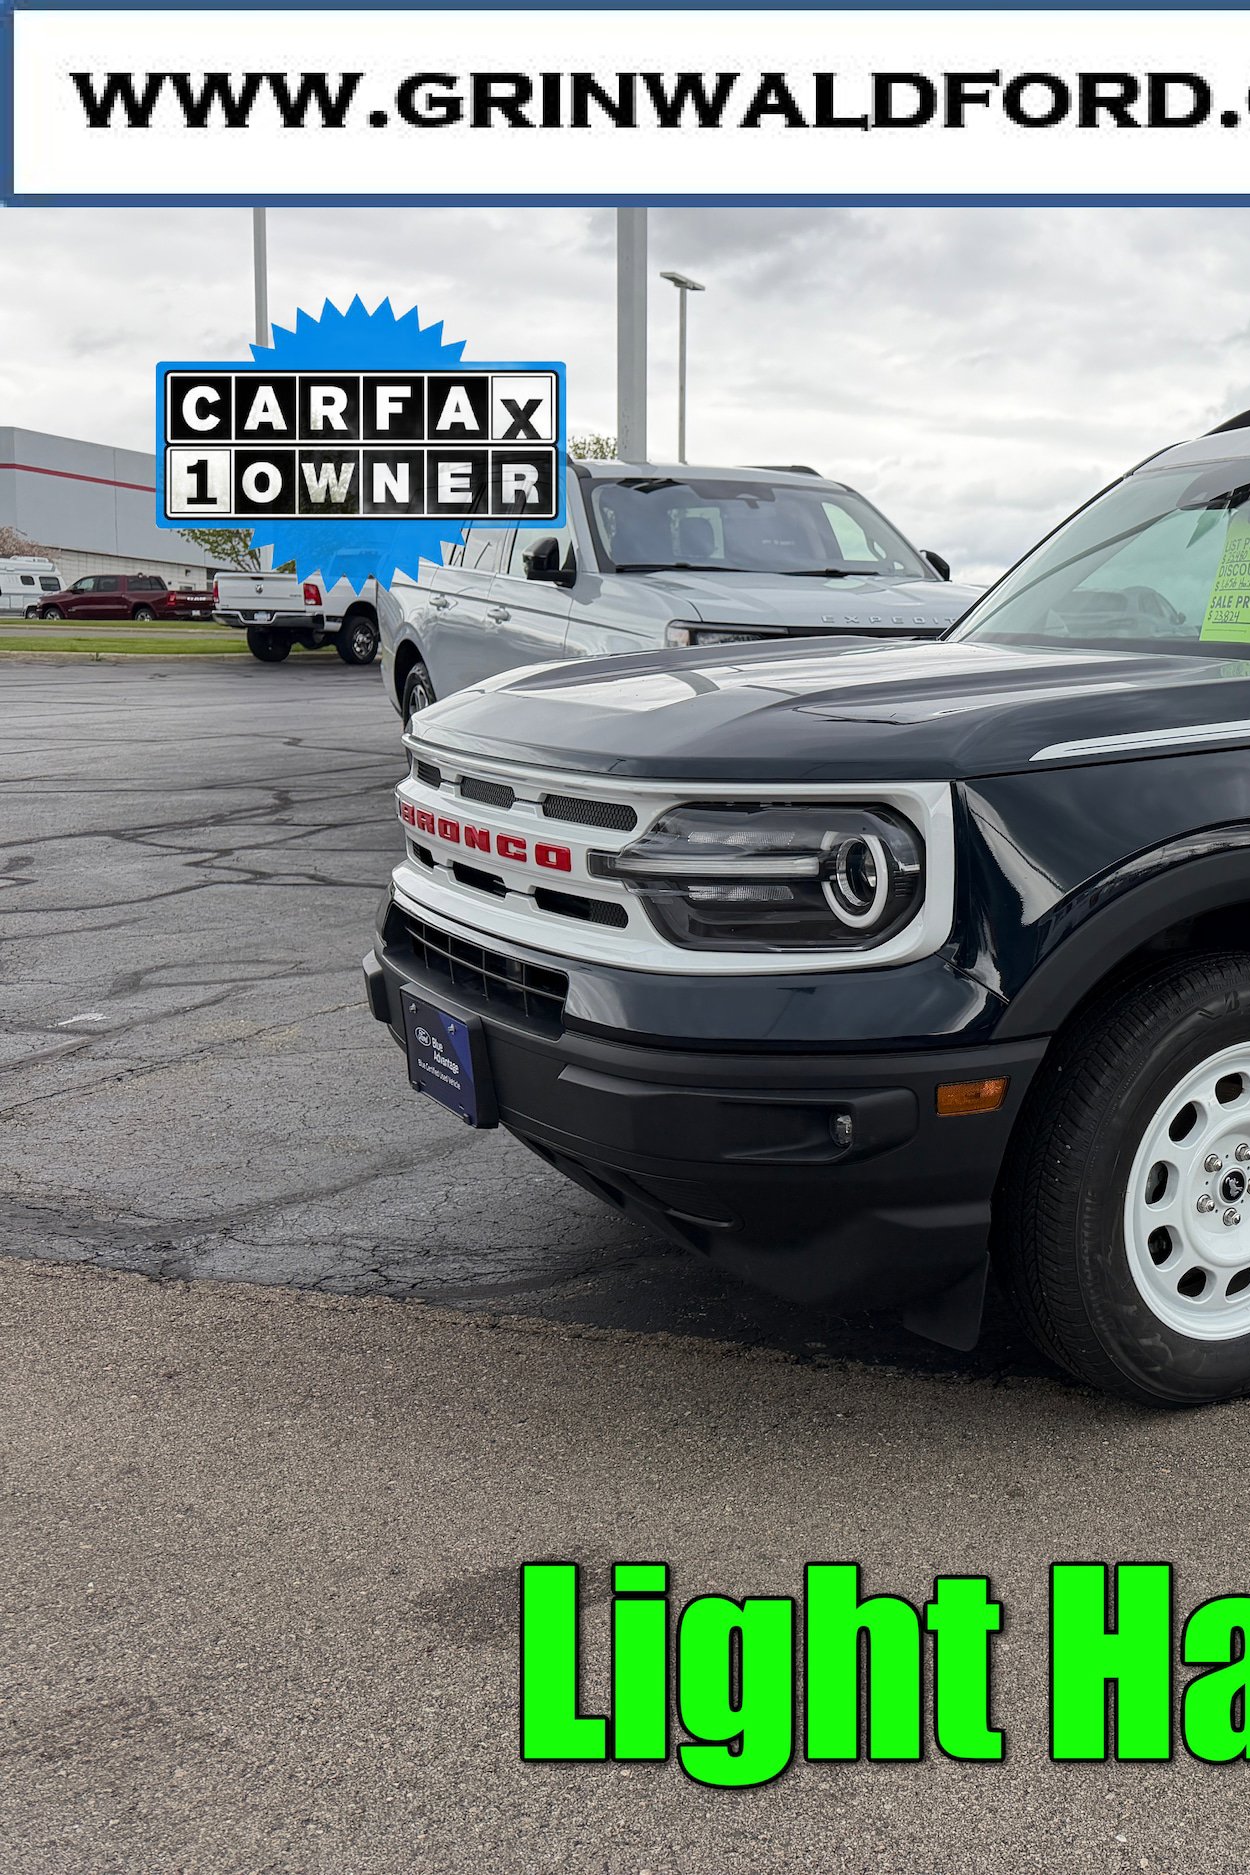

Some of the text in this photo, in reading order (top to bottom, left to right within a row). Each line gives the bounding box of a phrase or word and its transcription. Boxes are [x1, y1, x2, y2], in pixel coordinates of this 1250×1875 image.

[1225, 538, 1242, 552] LIST
[1210, 595, 1234, 609] SALE
[401, 799, 572, 873] BRONCO
[431, 1036, 443, 1053] Blue
[433, 1050, 460, 1075] Advantage
